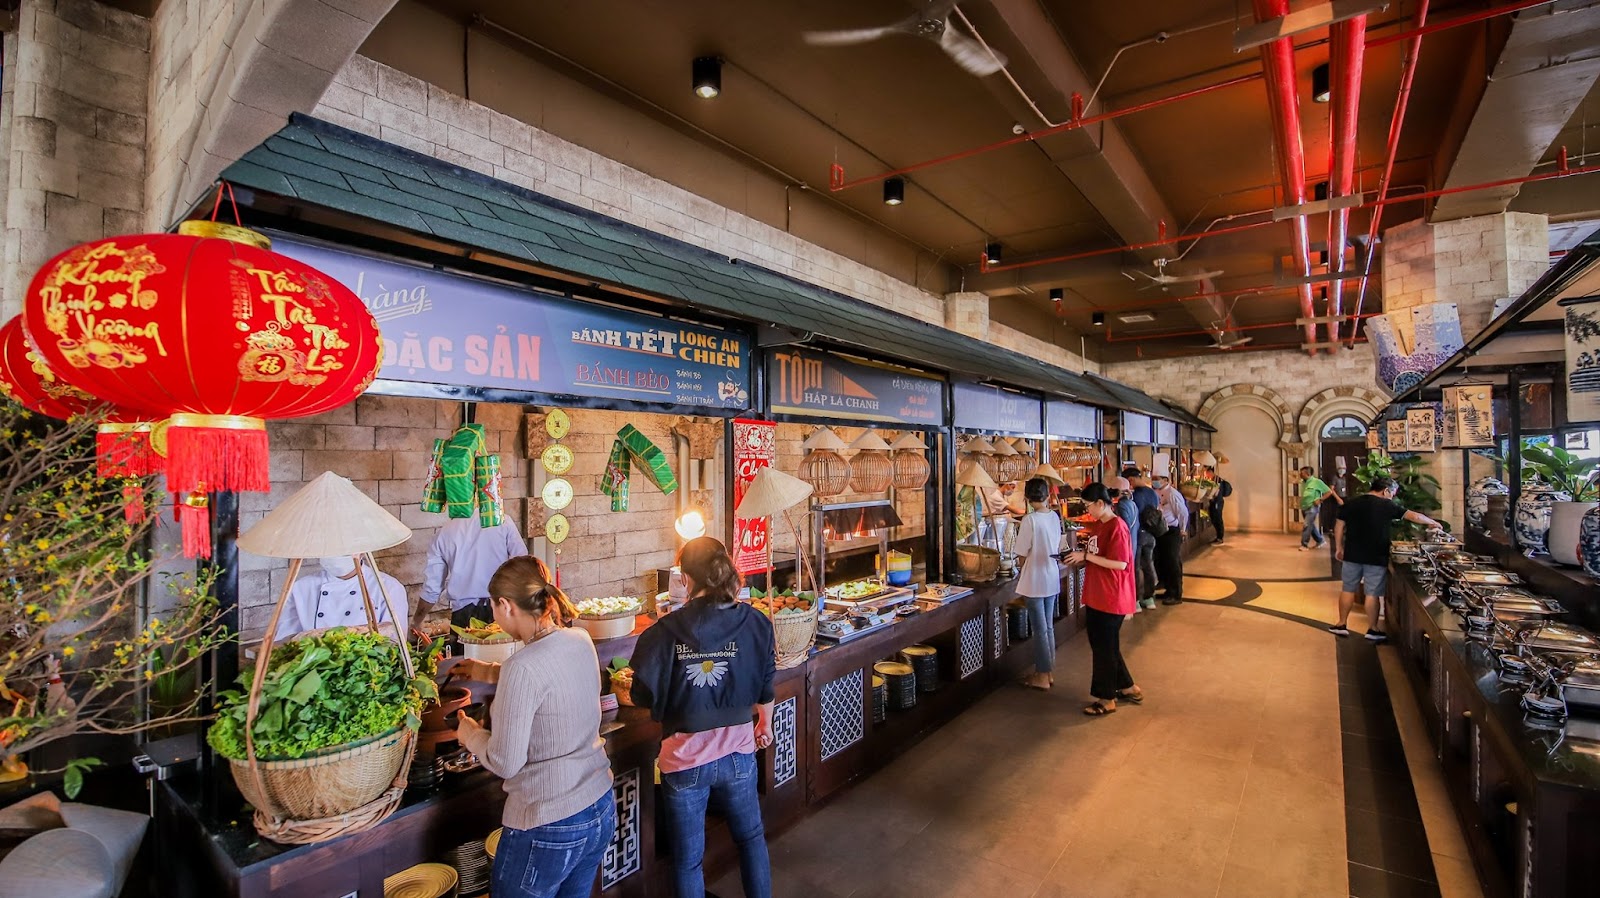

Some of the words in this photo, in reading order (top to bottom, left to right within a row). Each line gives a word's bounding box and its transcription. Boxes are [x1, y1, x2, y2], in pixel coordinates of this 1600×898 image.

[55, 260, 146, 307] Khang
[74, 310, 167, 356] Vượng
[572, 328, 622, 347] BÁNH
[679, 330, 717, 350] LONG
[721, 338, 740, 354] AN
[463, 324, 541, 382] SẢN
[576, 361, 630, 386] BÁNH
[635, 367, 670, 391] BÈO
[846, 397, 880, 410] CHANH
